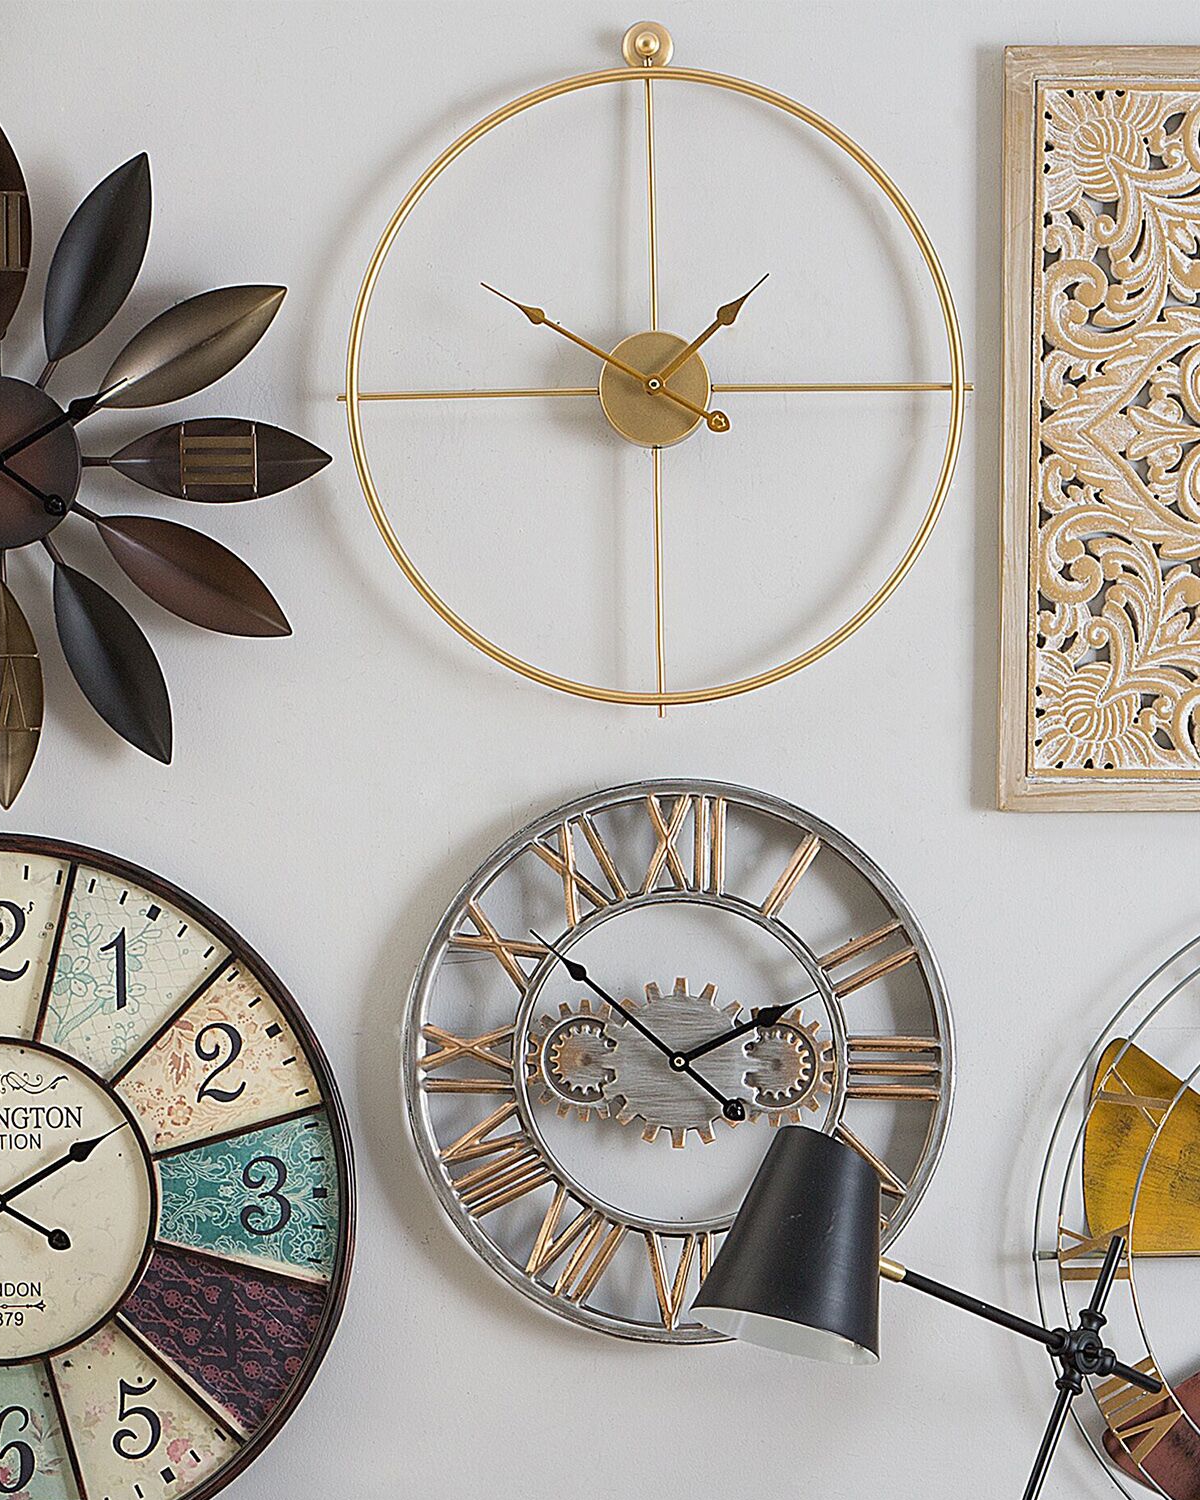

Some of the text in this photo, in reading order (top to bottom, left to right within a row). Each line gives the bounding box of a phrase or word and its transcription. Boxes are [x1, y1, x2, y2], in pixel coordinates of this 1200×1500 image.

[180, 422, 260, 498] III
[532, 812, 629, 928] XI
[643, 793, 727, 896] XII
[100, 926, 129, 1011] 1
[448, 899, 552, 994] X
[195, 1022, 247, 1104] 2
[420, 1022, 517, 1093] IX
[846, 1035, 942, 1101] III
[240, 1156, 289, 1235] 3
[111, 1376, 161, 1460] 5
